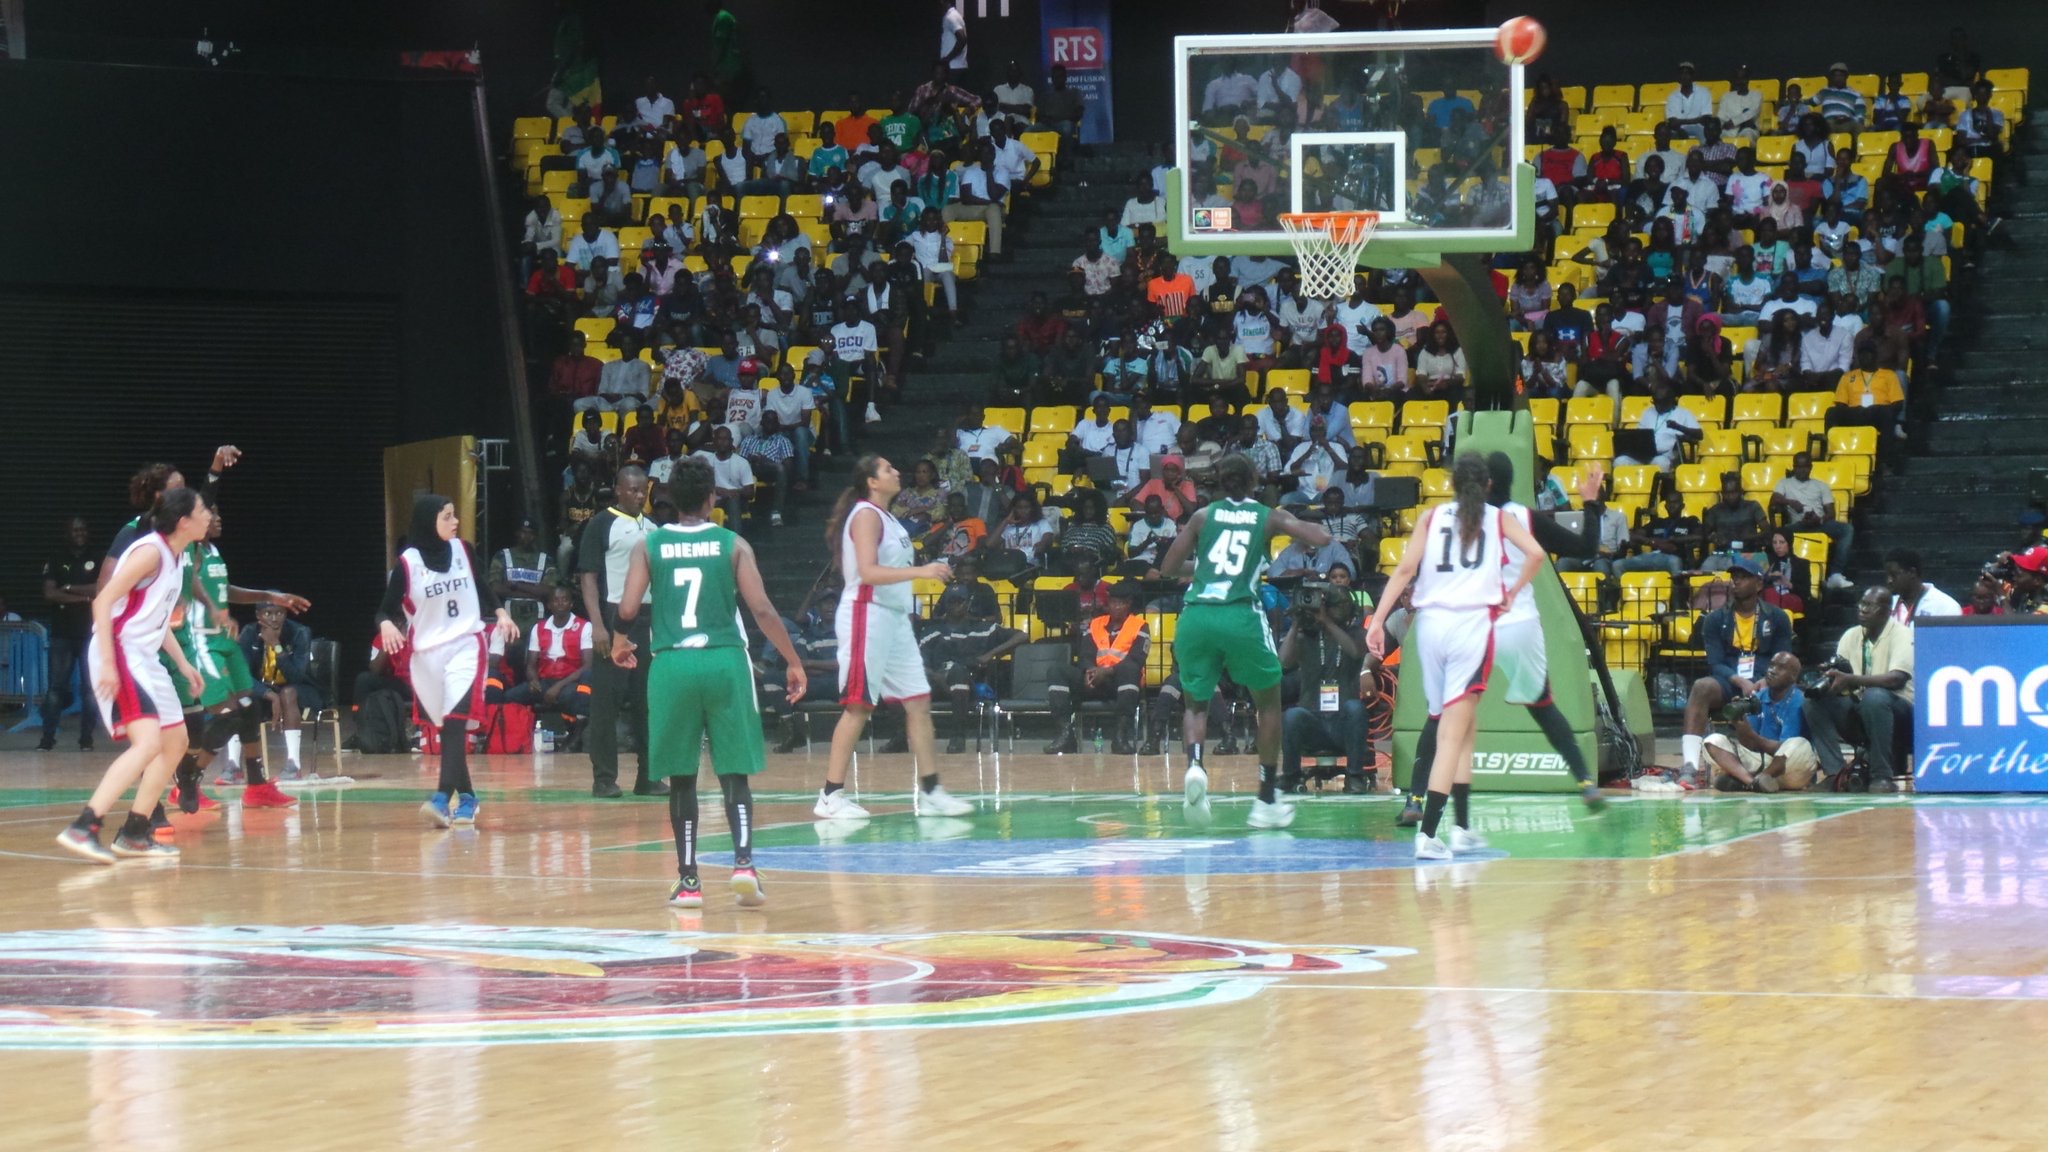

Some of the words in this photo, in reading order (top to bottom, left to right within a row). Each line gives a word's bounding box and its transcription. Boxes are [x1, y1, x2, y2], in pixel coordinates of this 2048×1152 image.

[1053, 36, 1097, 62] RTS
[838, 336, 863, 348] GCU
[729, 410, 747, 423] 23
[660, 541, 721, 559] DIEME
[1208, 529, 1251, 576] 45
[1436, 527, 1486, 572] 10
[425, 577, 469, 598] EGYPT
[674, 567, 703, 629] 7
[447, 599, 459, 618] 8
[1916, 742, 1983, 778] For
[1987, 739, 2048, 775] the
